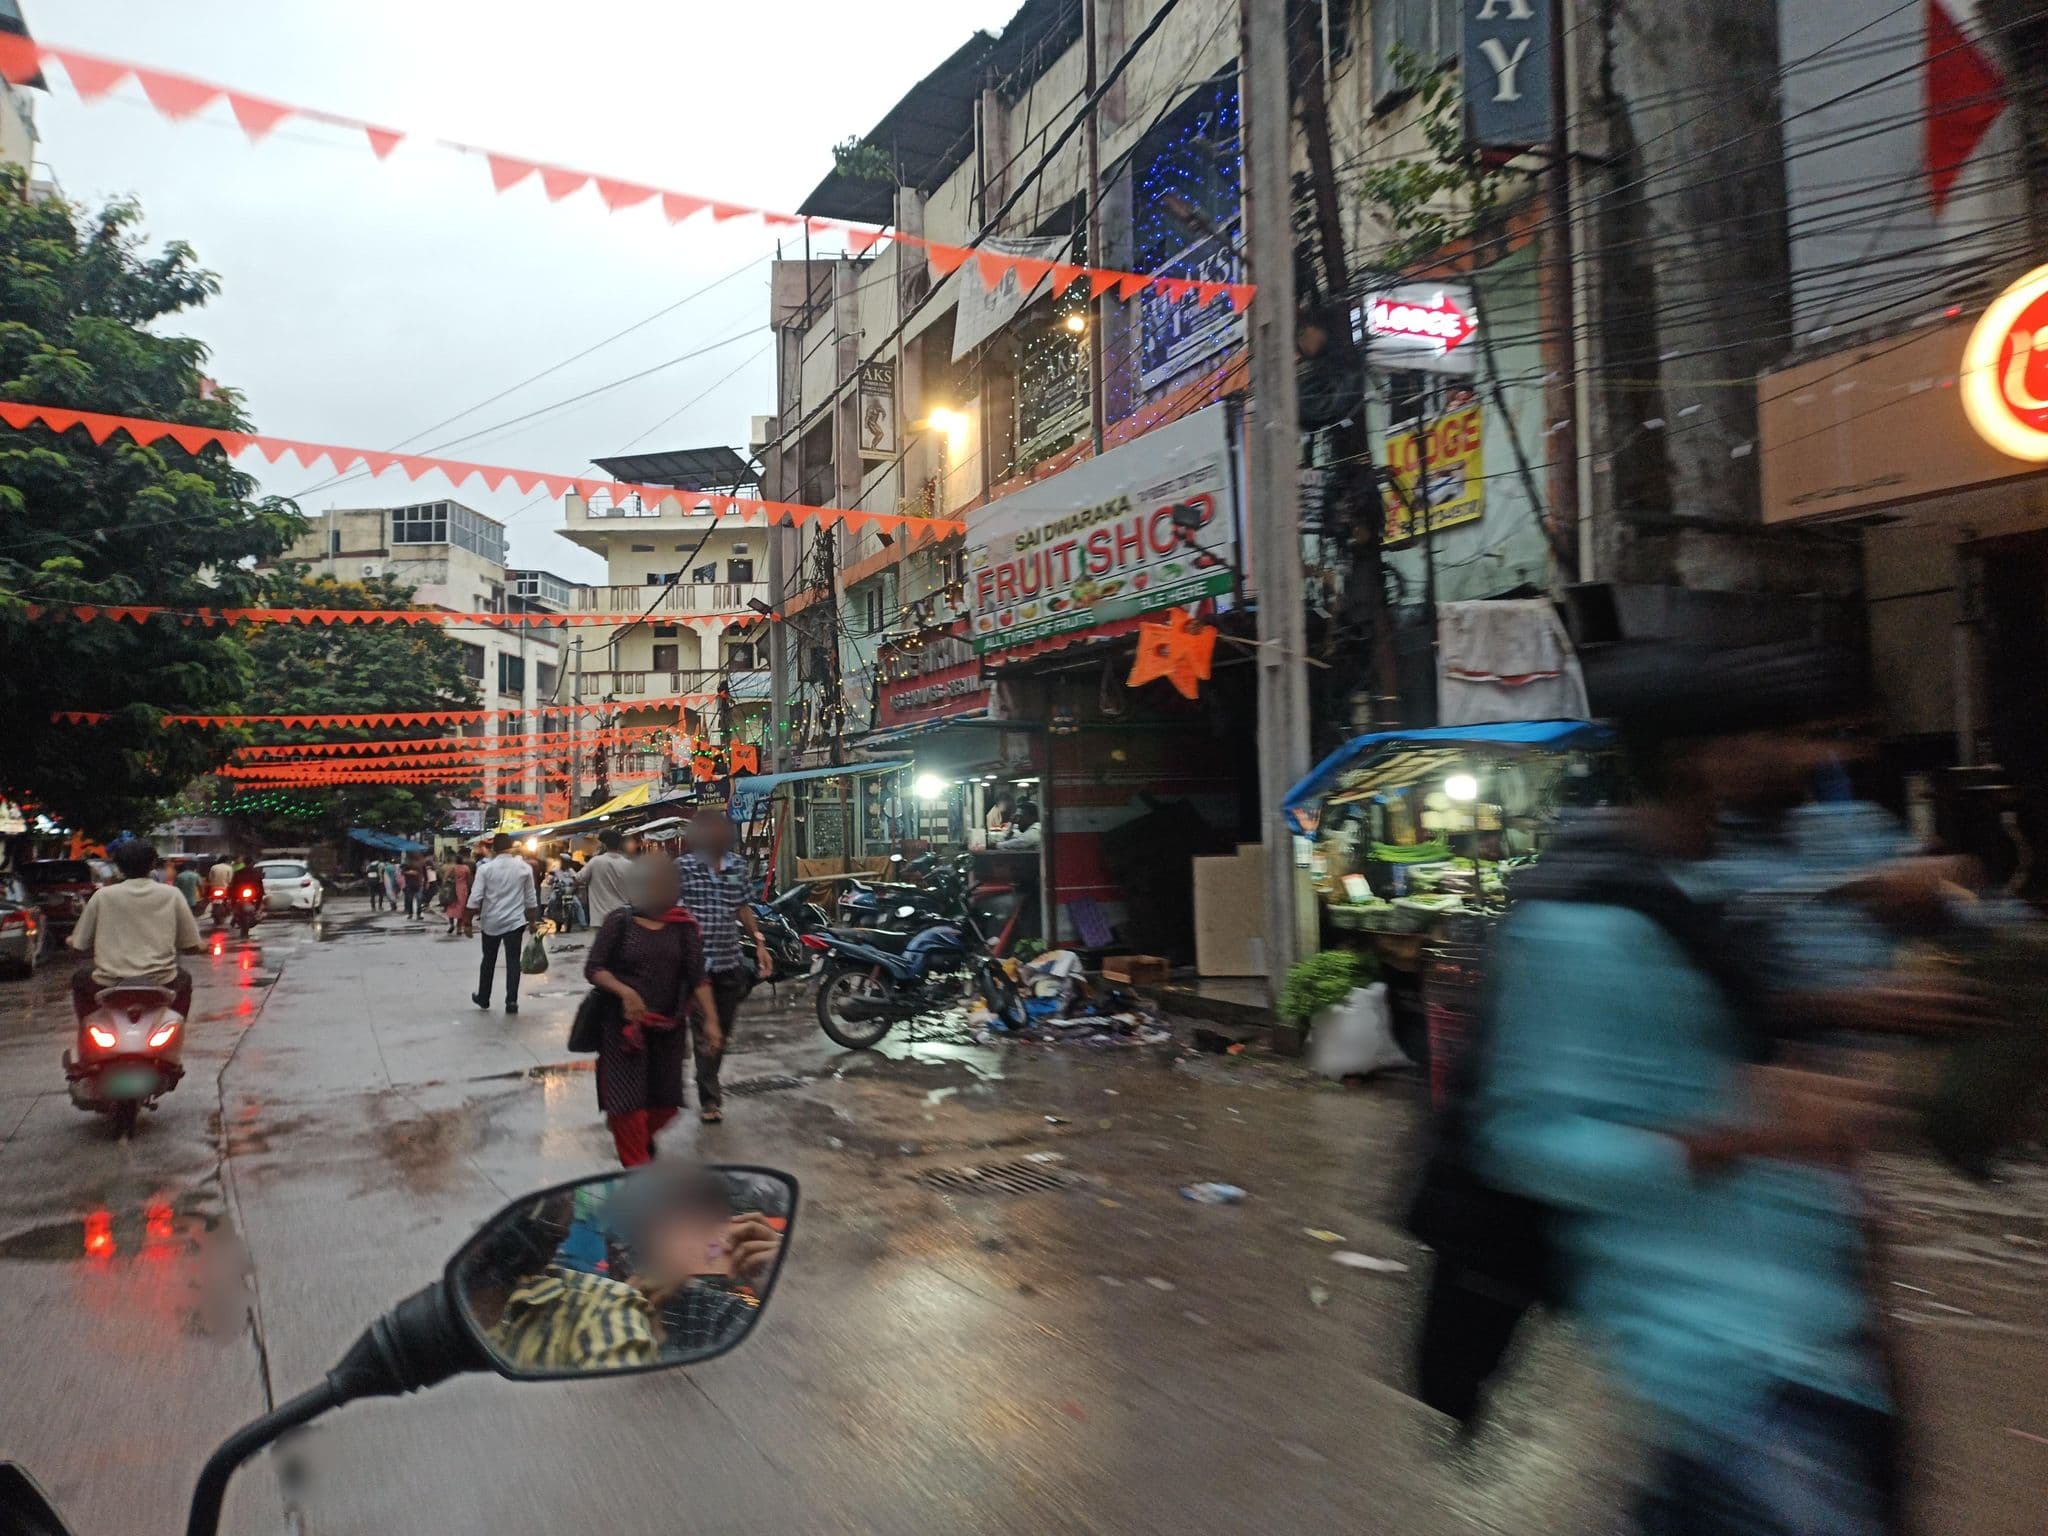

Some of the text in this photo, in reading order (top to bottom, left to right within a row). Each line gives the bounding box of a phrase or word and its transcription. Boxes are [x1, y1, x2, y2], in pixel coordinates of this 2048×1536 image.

[863, 368, 892, 383] AKS
[1387, 411, 1480, 478] LODGE
[1014, 496, 1131, 551] SAI DWARAKA
[976, 540, 1079, 611] FRUIT
[1169, 581, 1208, 602] HERE
[983, 609, 1094, 650] ALL TYPES OF FRUITS
